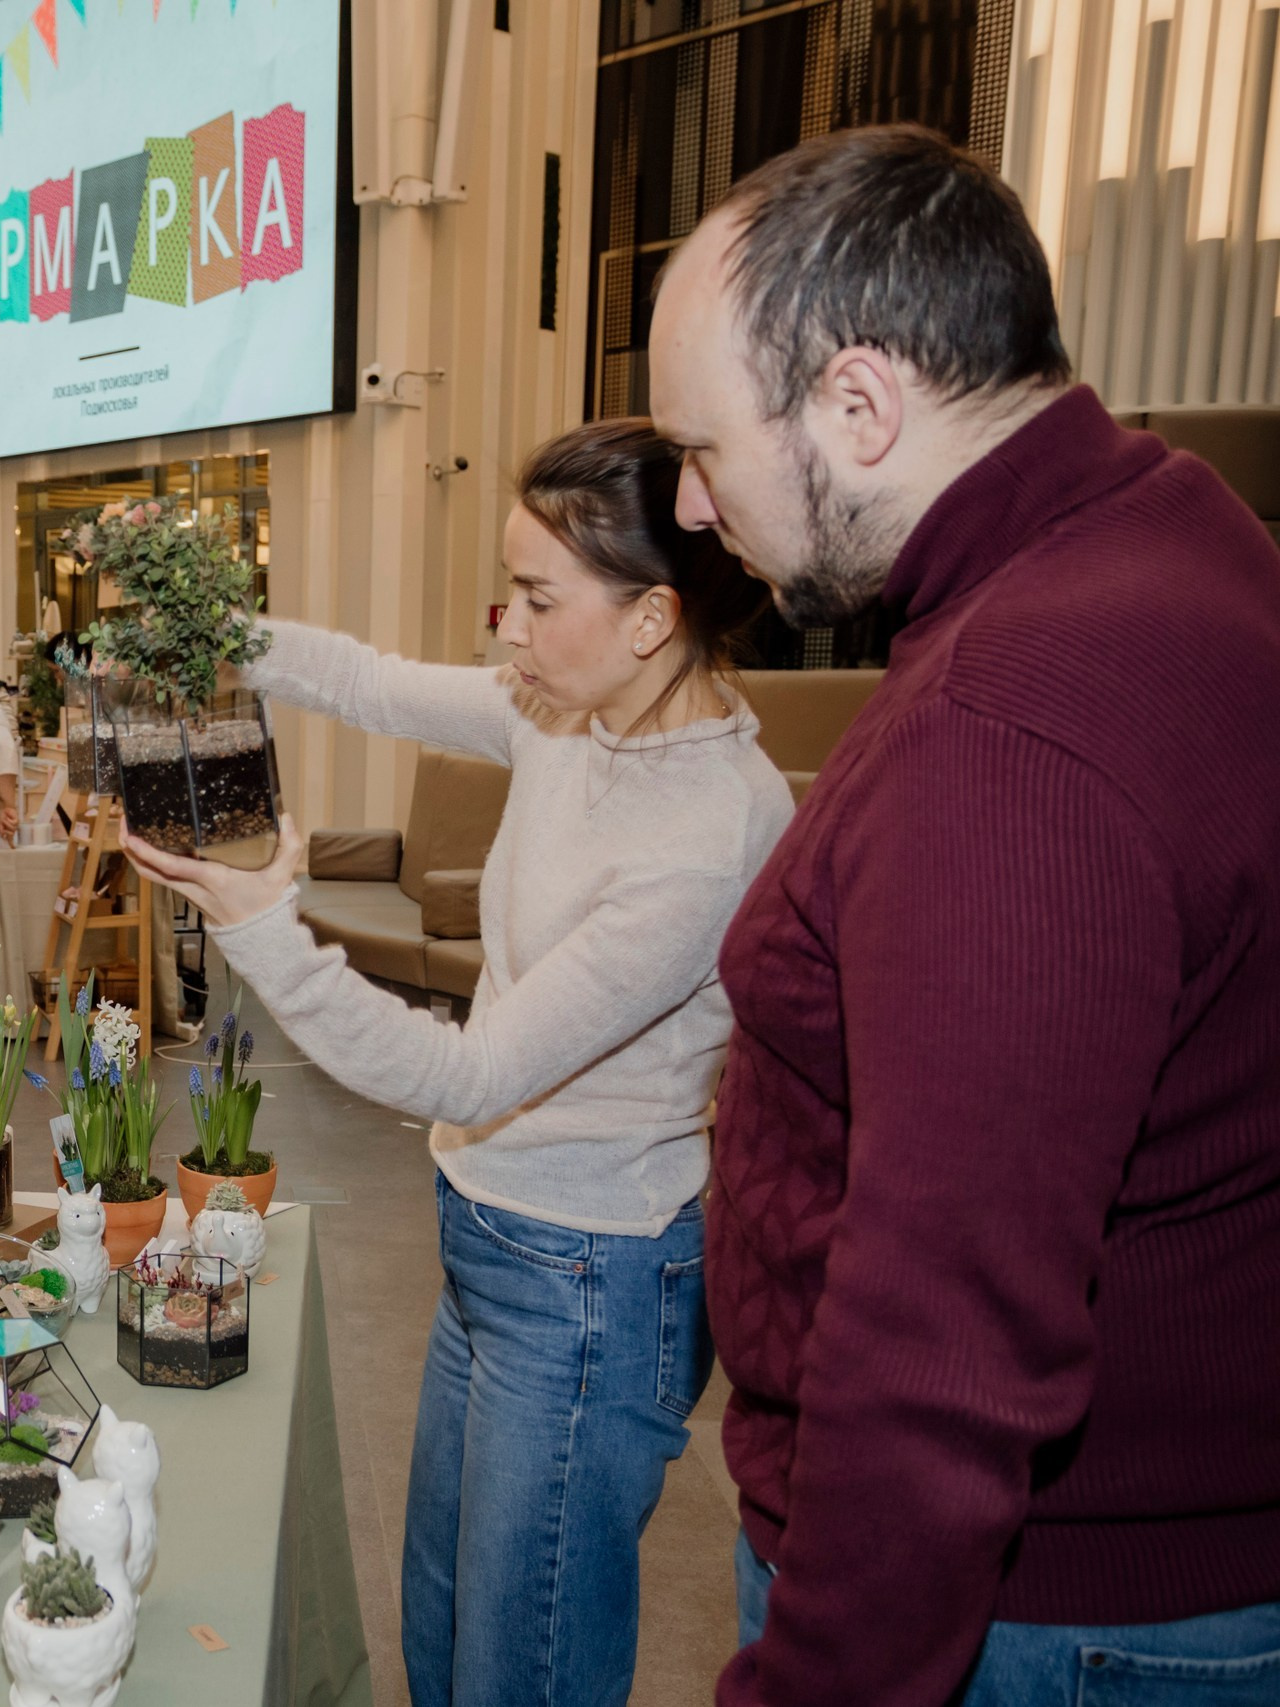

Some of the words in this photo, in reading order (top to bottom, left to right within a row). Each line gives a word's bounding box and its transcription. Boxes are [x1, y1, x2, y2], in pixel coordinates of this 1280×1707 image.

[52, 380, 97, 399] локальных
[99, 363, 170, 392] производителей
[80, 396, 139, 417] Подмосковья
